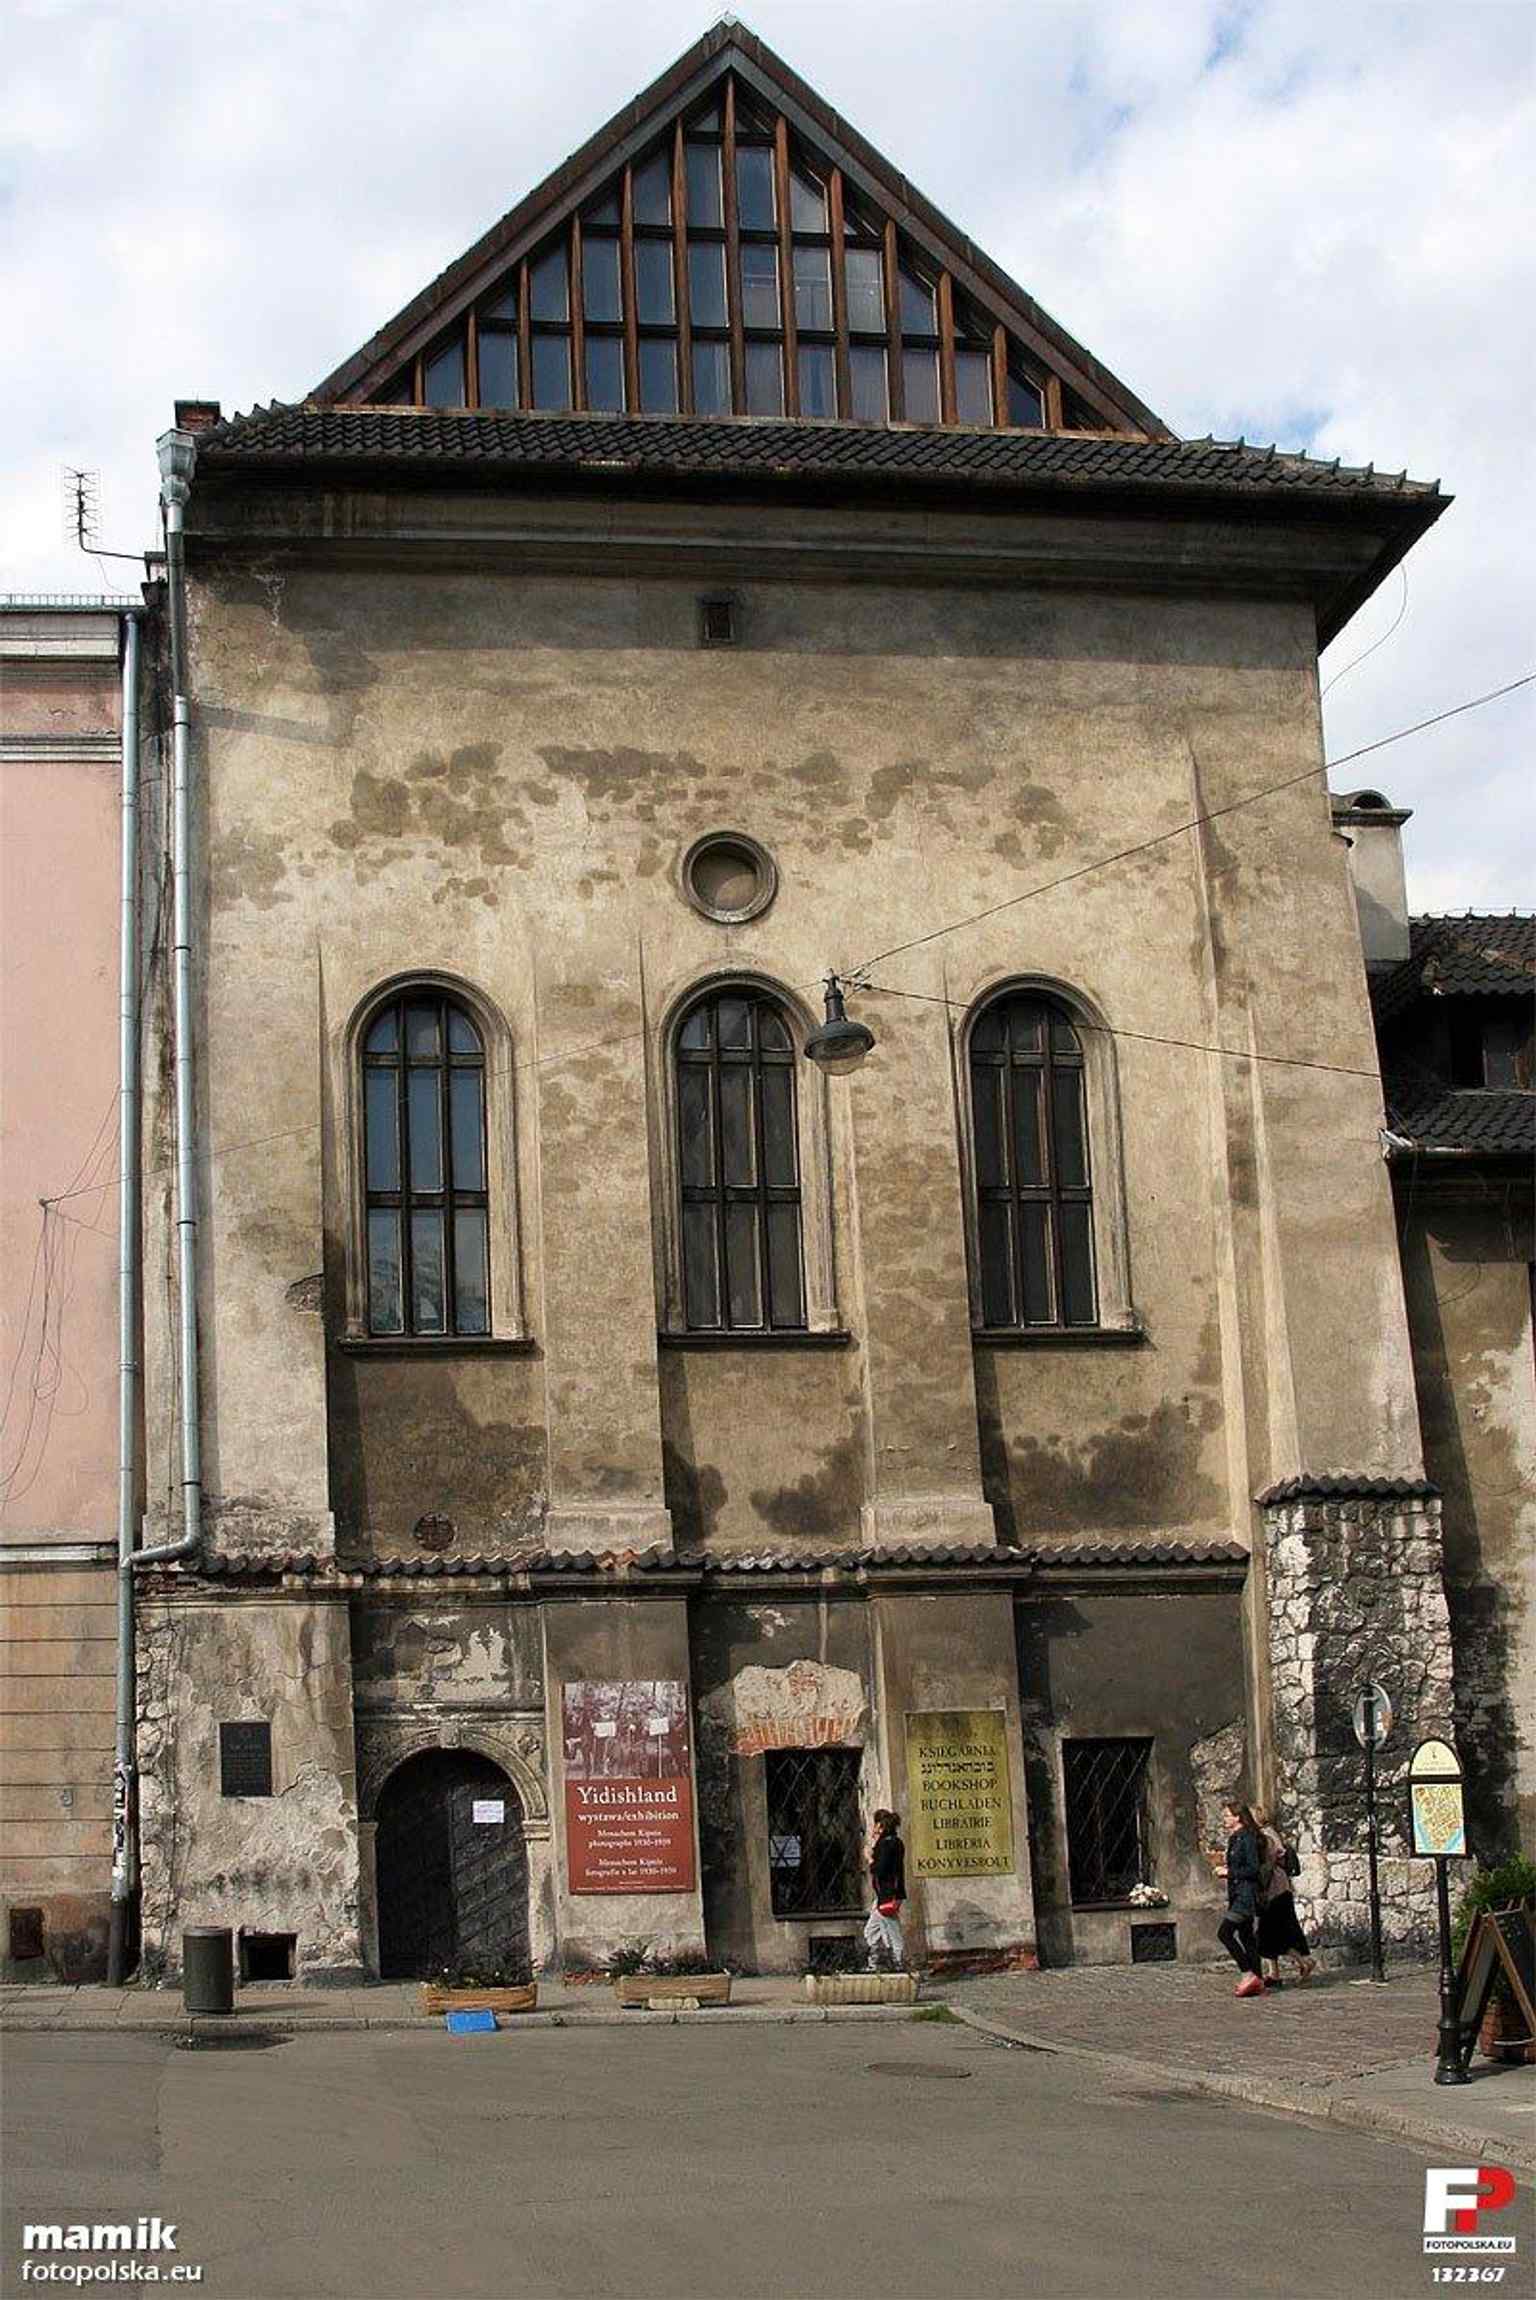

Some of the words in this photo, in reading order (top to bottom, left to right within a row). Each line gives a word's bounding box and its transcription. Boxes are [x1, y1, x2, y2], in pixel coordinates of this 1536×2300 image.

[922, 1778, 998, 1793] BOOKSHOP
[577, 1785, 677, 1804] Yidishland
[921, 1797, 1002, 1811] BUCHLADEN
[577, 1810, 679, 1825] wystawa/exhibition
[932, 1816, 993, 1830] LIBRAIRIE
[936, 1837, 991, 1851] LIBRERIA
